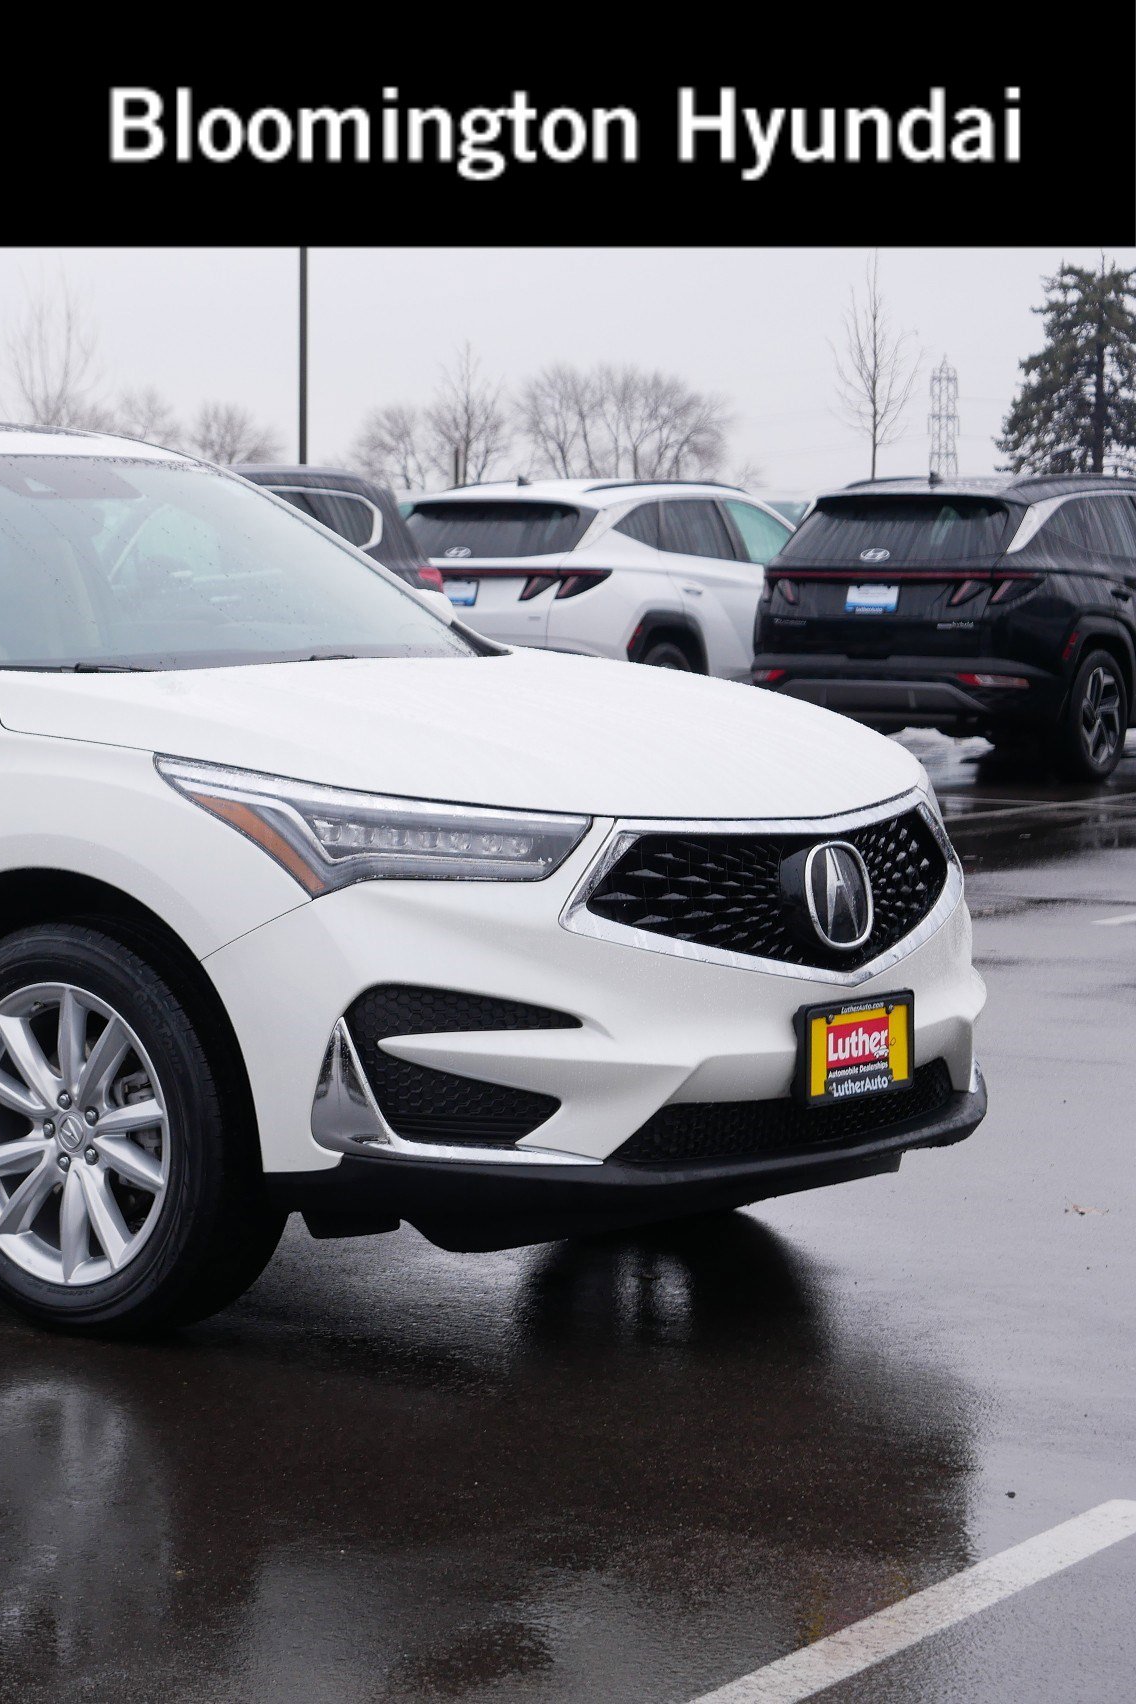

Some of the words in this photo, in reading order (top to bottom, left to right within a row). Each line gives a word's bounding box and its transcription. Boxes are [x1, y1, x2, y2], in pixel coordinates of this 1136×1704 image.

[841, 1002, 884, 1014] LutherAuto.com
[828, 1027, 888, 1061] Luther
[828, 1066, 858, 1078] Automobile
[859, 1061, 888, 1073] Dealerships
[833, 1075, 888, 1097] LutherAuto
